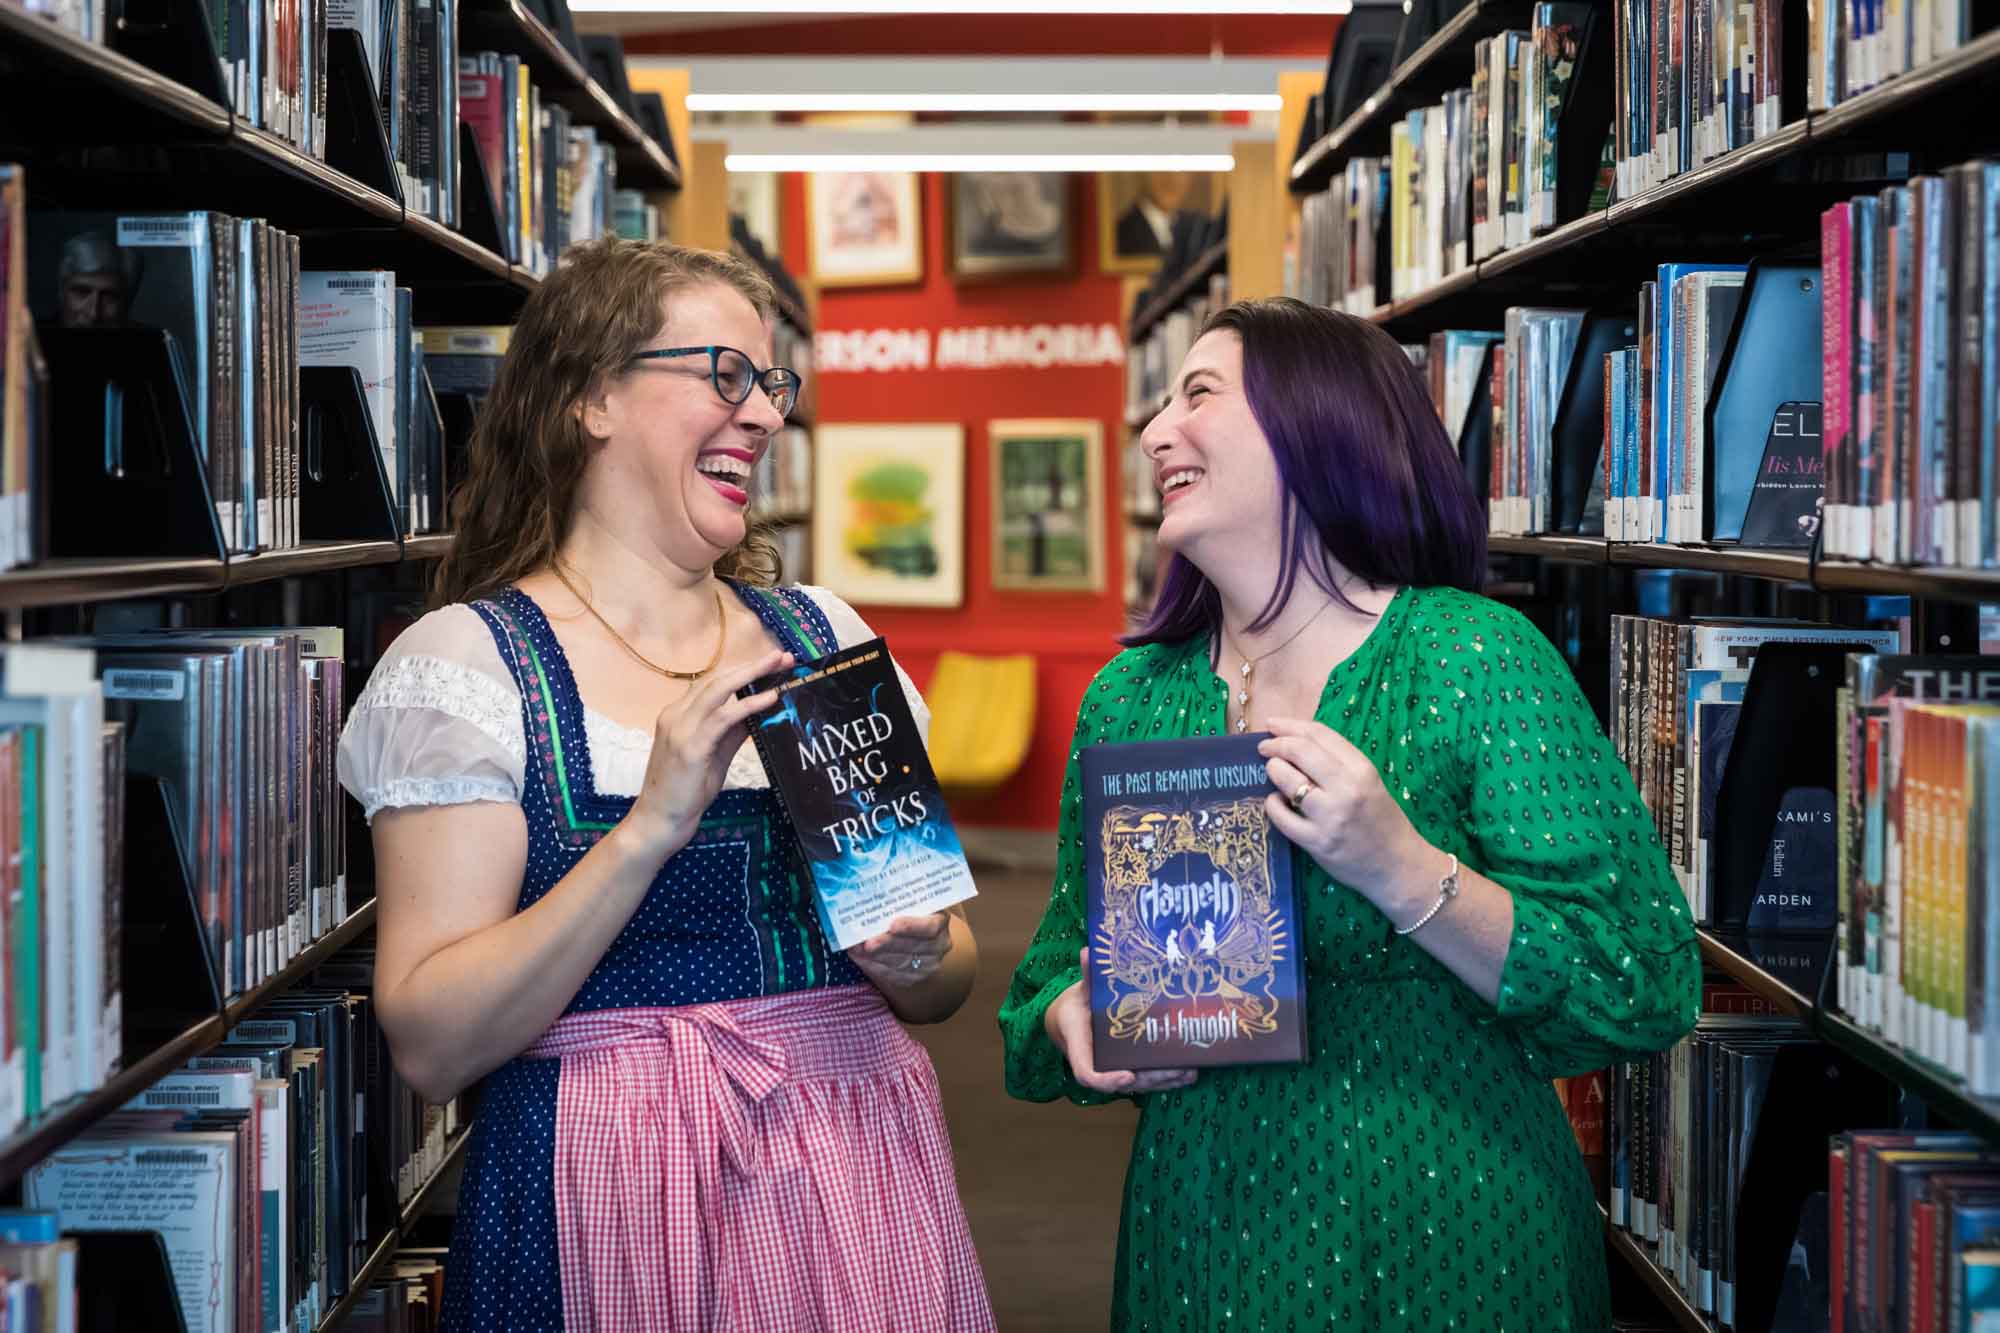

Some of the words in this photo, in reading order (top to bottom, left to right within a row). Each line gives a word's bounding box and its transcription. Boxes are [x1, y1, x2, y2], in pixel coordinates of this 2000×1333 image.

[797, 711, 894, 771] MIXED
[827, 749, 889, 797] BAG
[1102, 774, 1121, 797] THE
[1126, 771, 1151, 794] PAST
[1155, 767, 1211, 795] REMAINS
[1215, 763, 1267, 788] UNSUNG
[857, 787, 879, 807] OF
[823, 790, 927, 855] TRICKS
[1757, 894, 1812, 905] ARDEN
